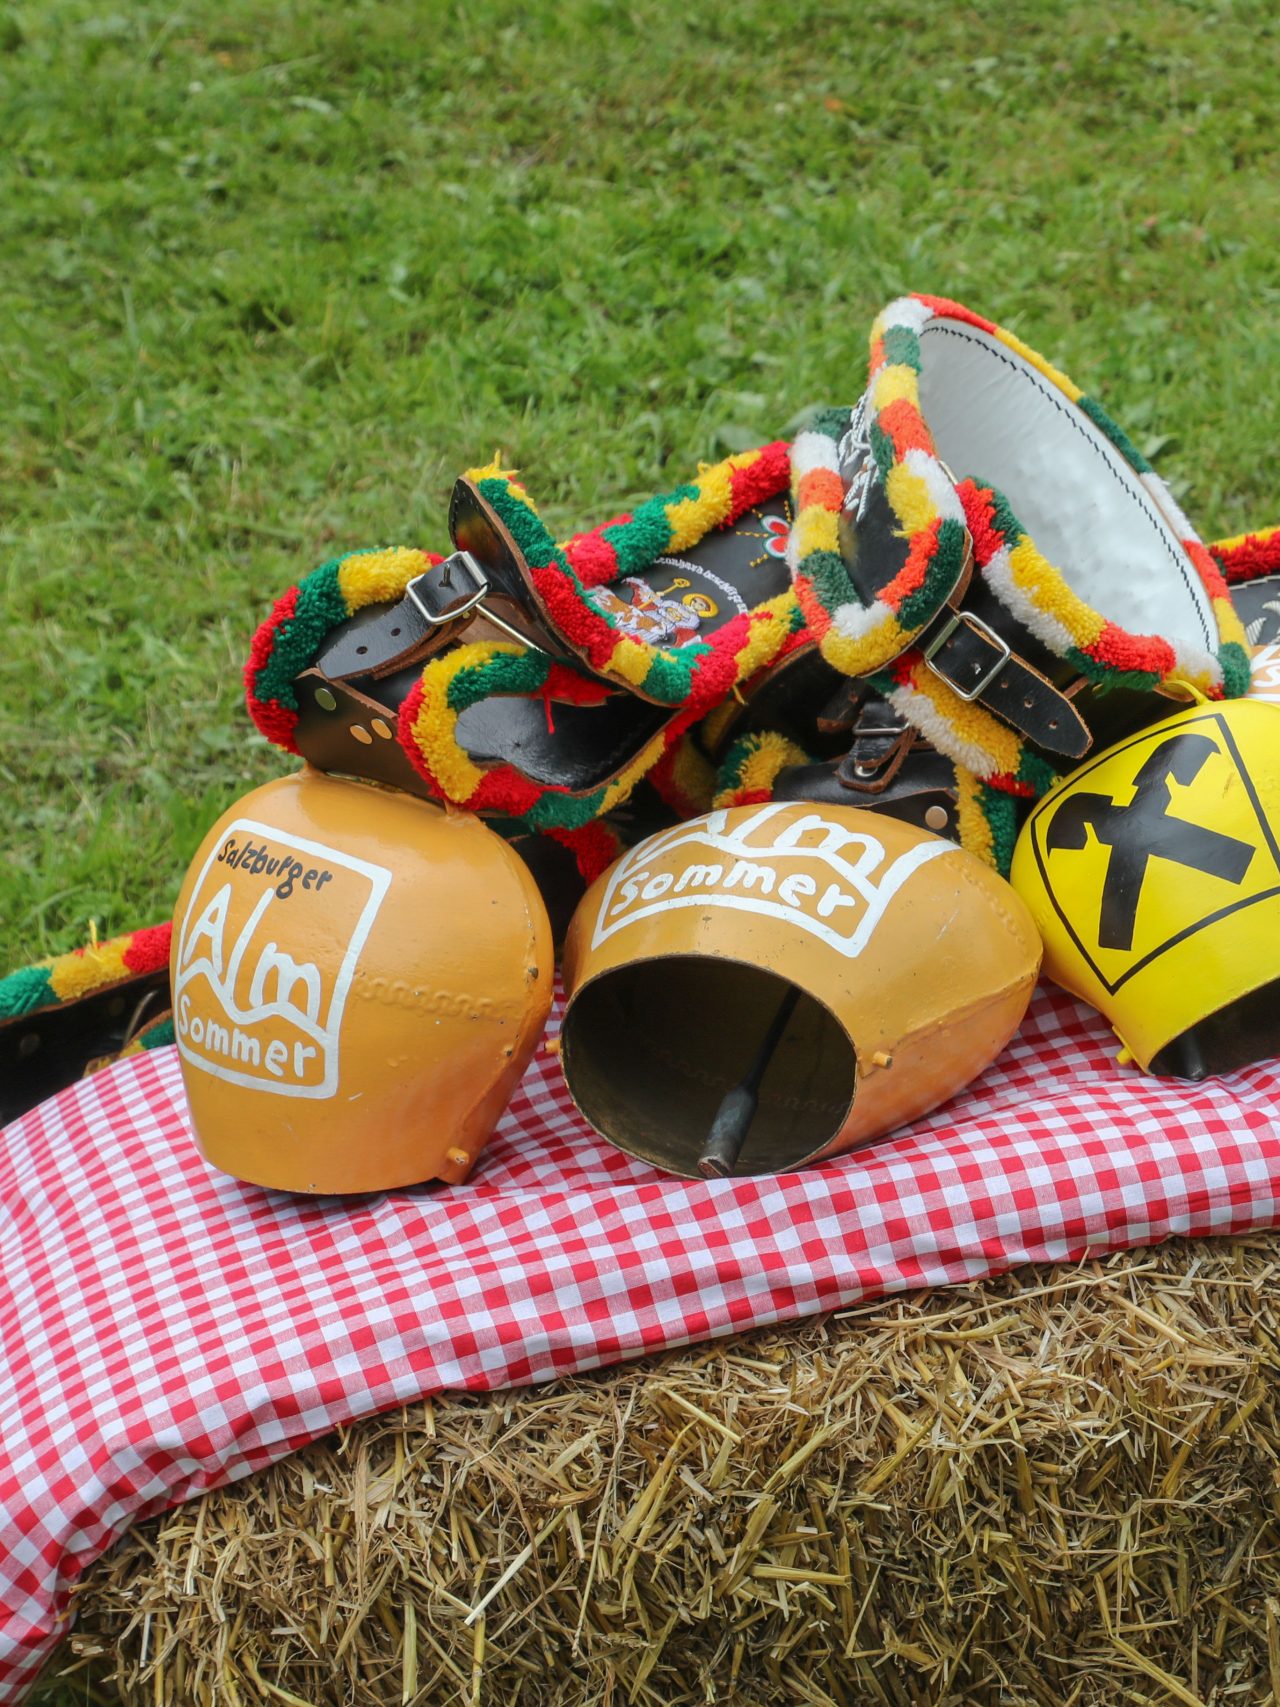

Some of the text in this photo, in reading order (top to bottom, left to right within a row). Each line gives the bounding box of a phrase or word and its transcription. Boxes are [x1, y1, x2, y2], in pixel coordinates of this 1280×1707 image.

[217, 839, 333, 900] Salzburger
[611, 860, 857, 918] Sommer
[183, 882, 322, 1025] Alm
[177, 995, 318, 1078] Sommer
